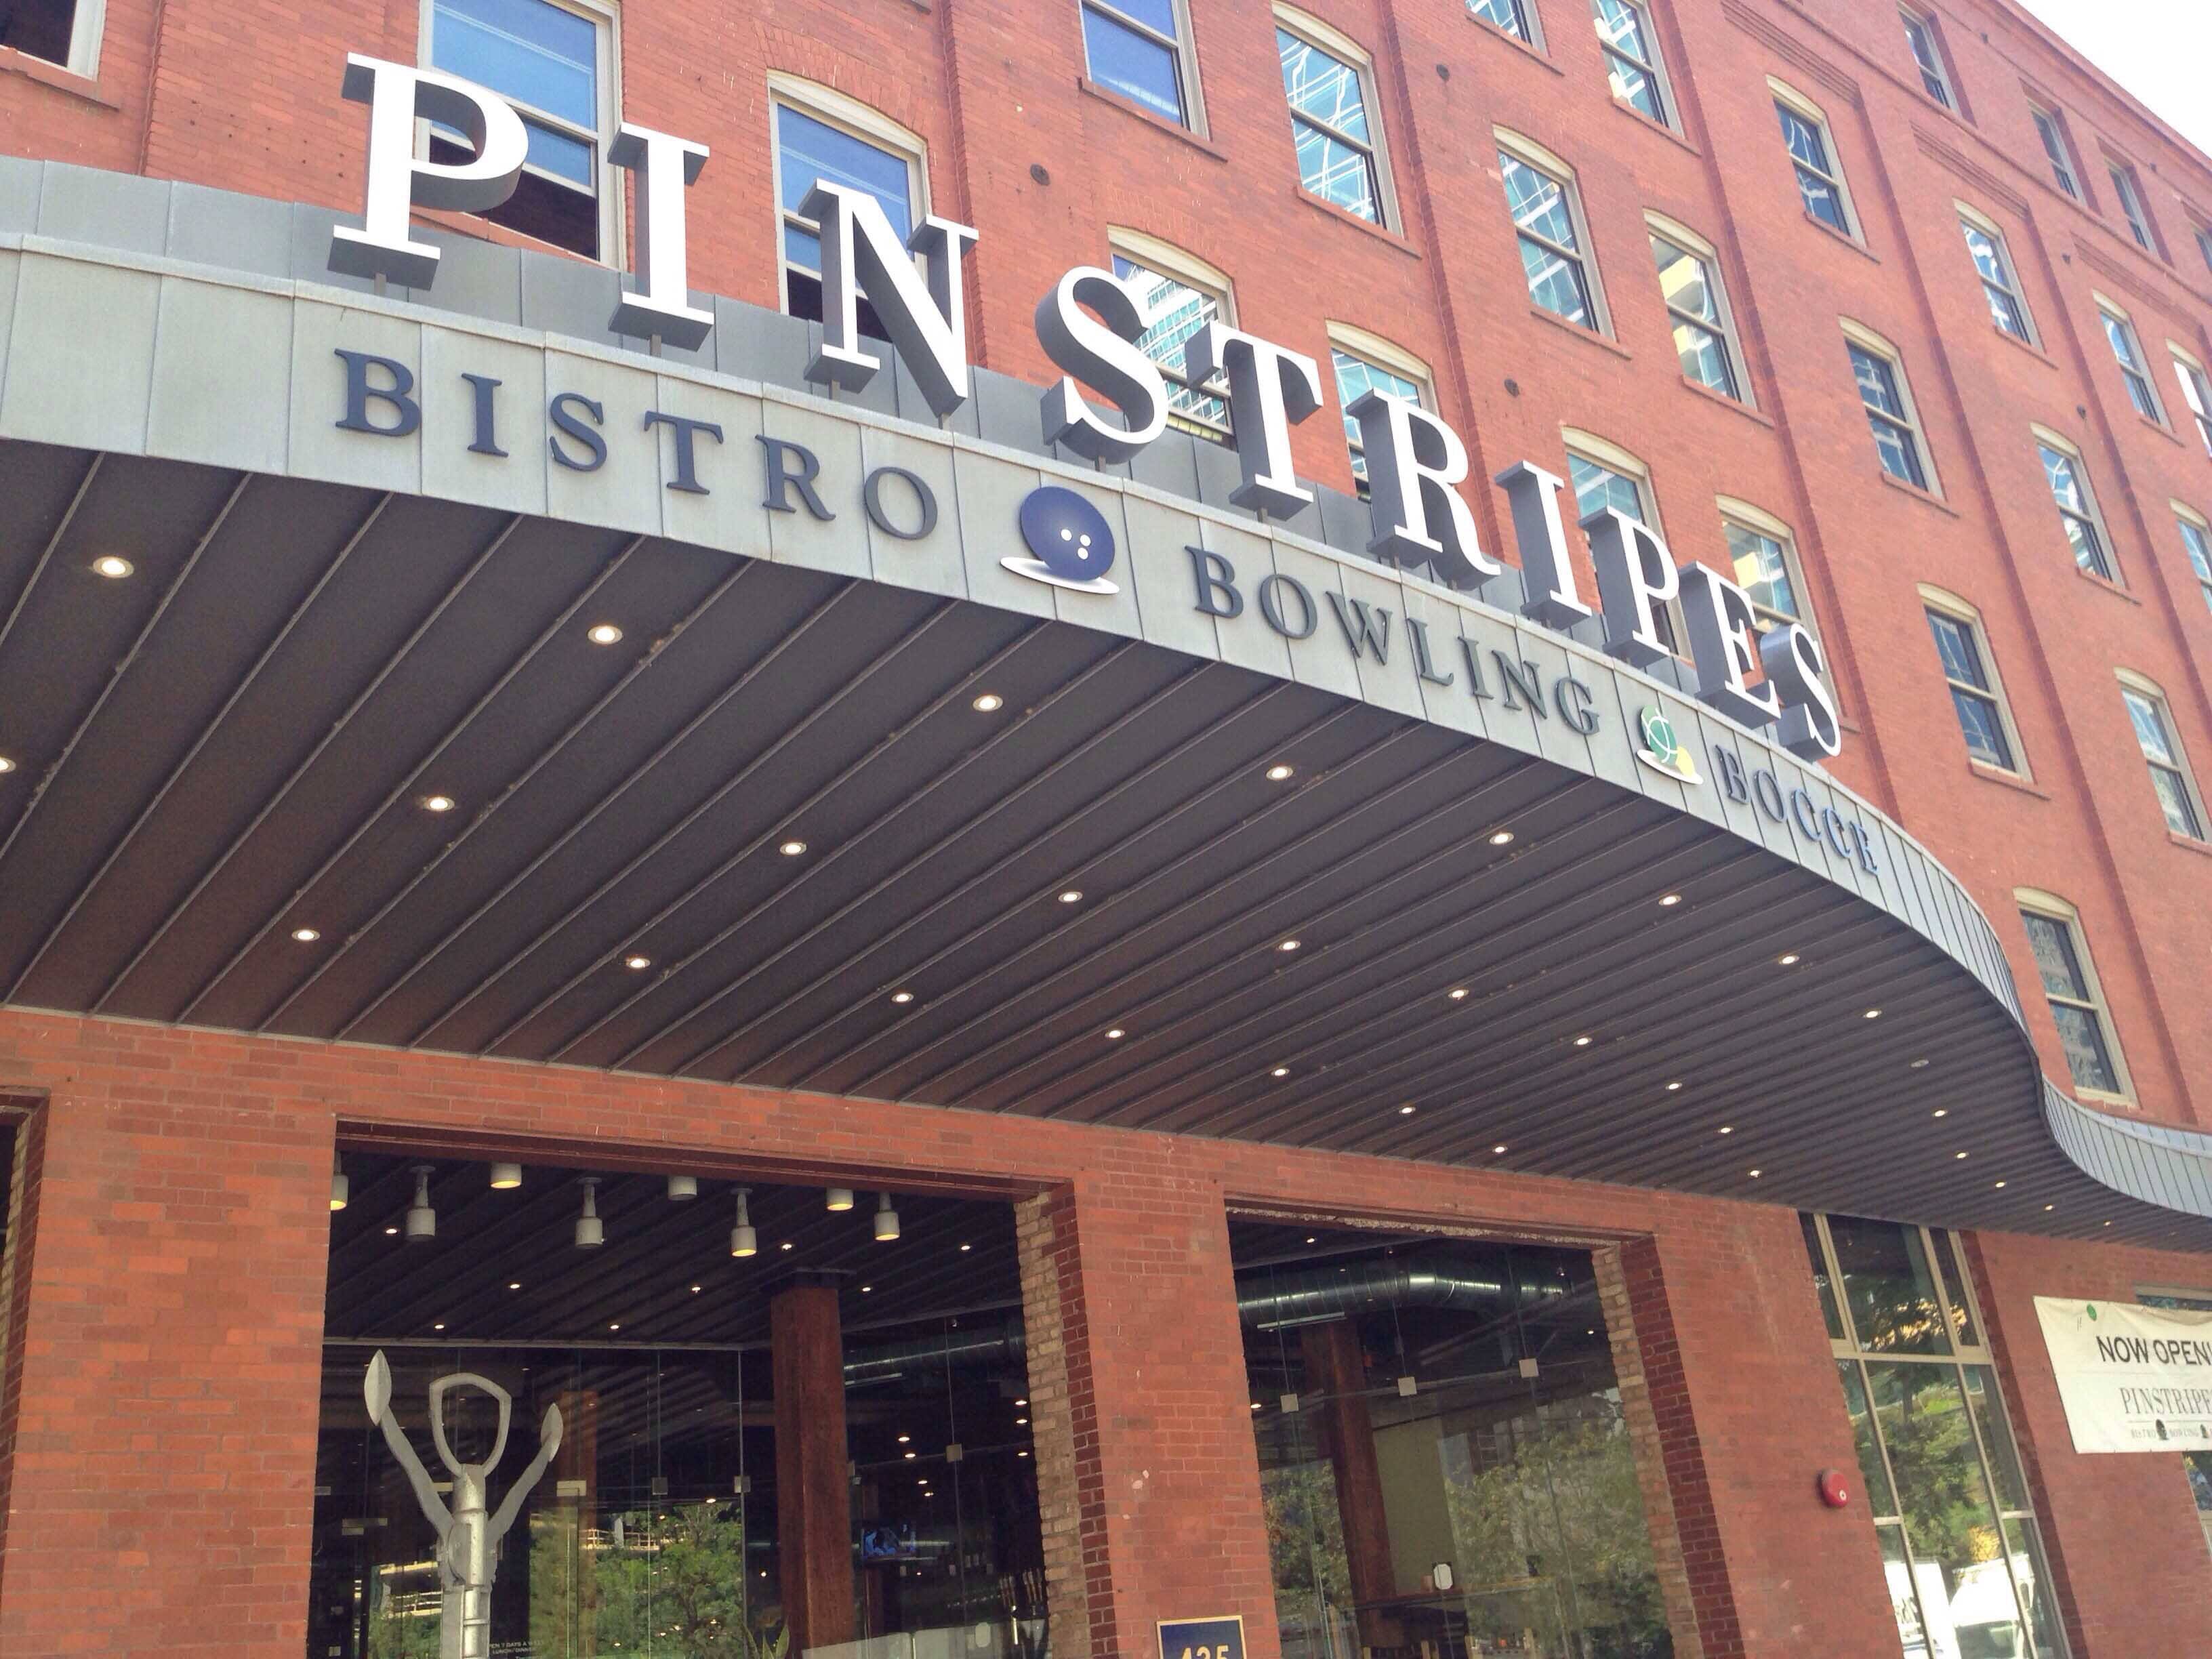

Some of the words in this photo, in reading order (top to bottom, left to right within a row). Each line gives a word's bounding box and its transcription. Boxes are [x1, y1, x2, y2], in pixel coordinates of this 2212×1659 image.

[331, 53, 1842, 758] PINSTRIPES
[334, 348, 938, 540] BISTRO
[1185, 545, 1600, 735] BOWLING
[1715, 744, 1878, 876] BOCCE
[2096, 1336, 2148, 1364] NOW
[2119, 1387, 2212, 1414] PINSTRIPE
